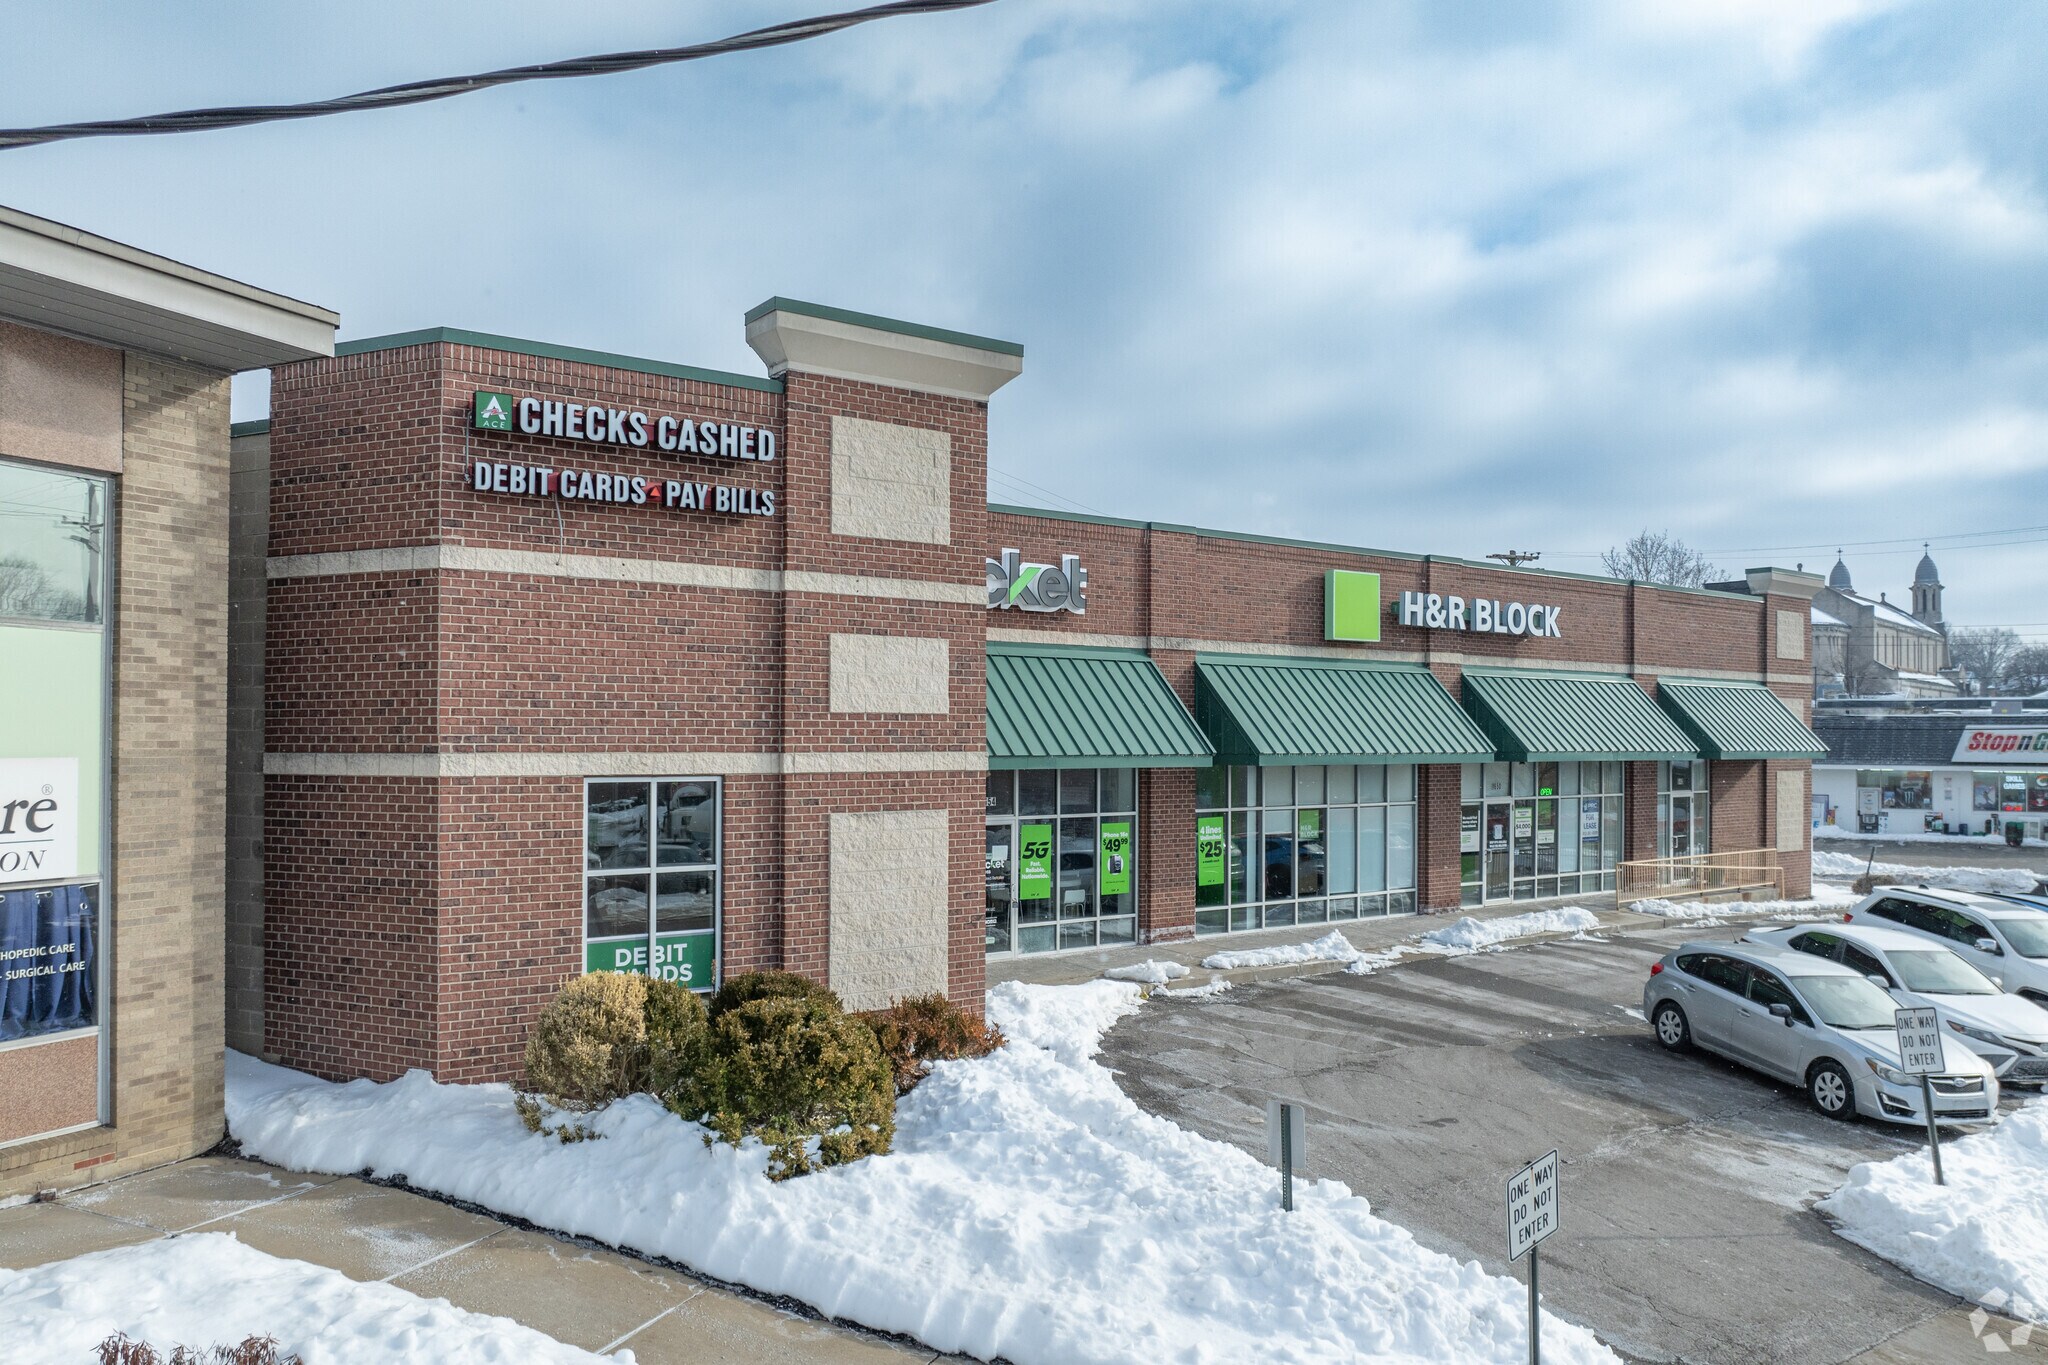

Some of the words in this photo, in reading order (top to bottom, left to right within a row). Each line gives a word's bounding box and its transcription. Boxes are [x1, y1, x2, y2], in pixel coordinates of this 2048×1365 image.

[482, 420, 505, 429] ACE
[519, 397, 648, 447] CHECKS
[658, 415, 776, 462] CASHED
[474, 461, 553, 496] DEBIT
[560, 469, 647, 505] CARDS
[666, 480, 709, 511] PAY
[715, 485, 775, 517] BILLS
[1402, 591, 1466, 630] H&R
[1474, 598, 1561, 638] BLOCK
[2005, 775, 2024, 783] SKILL
[1540, 788, 1552, 796] OPEN
[1200, 826, 1205, 834] 4
[1206, 826, 1222, 835] lines
[1583, 822, 1597, 830] LEASE
[1022, 842, 1050, 859] 5G
[1200, 841, 1222, 858] $25
[48, 943, 76, 955] CARE
[615, 943, 688, 967] DEBIT
[5, 965, 56, 981] SURGICAL
[59, 961, 86, 973] CARE
[1898, 1017, 1915, 1030] ONE
[1917, 1015, 1934, 1028] WAY
[1902, 1035, 1914, 1048] DO
[1919, 1034, 1936, 1047] NOT
[1908, 1053, 1936, 1066] ENTER
[1510, 1178, 1530, 1203] ONE
[1534, 1161, 1554, 1187] WAY
[1514, 1204, 1527, 1225] DO
[1533, 1186, 1552, 1211] NOT
[1518, 1212, 1549, 1245] ENTER
